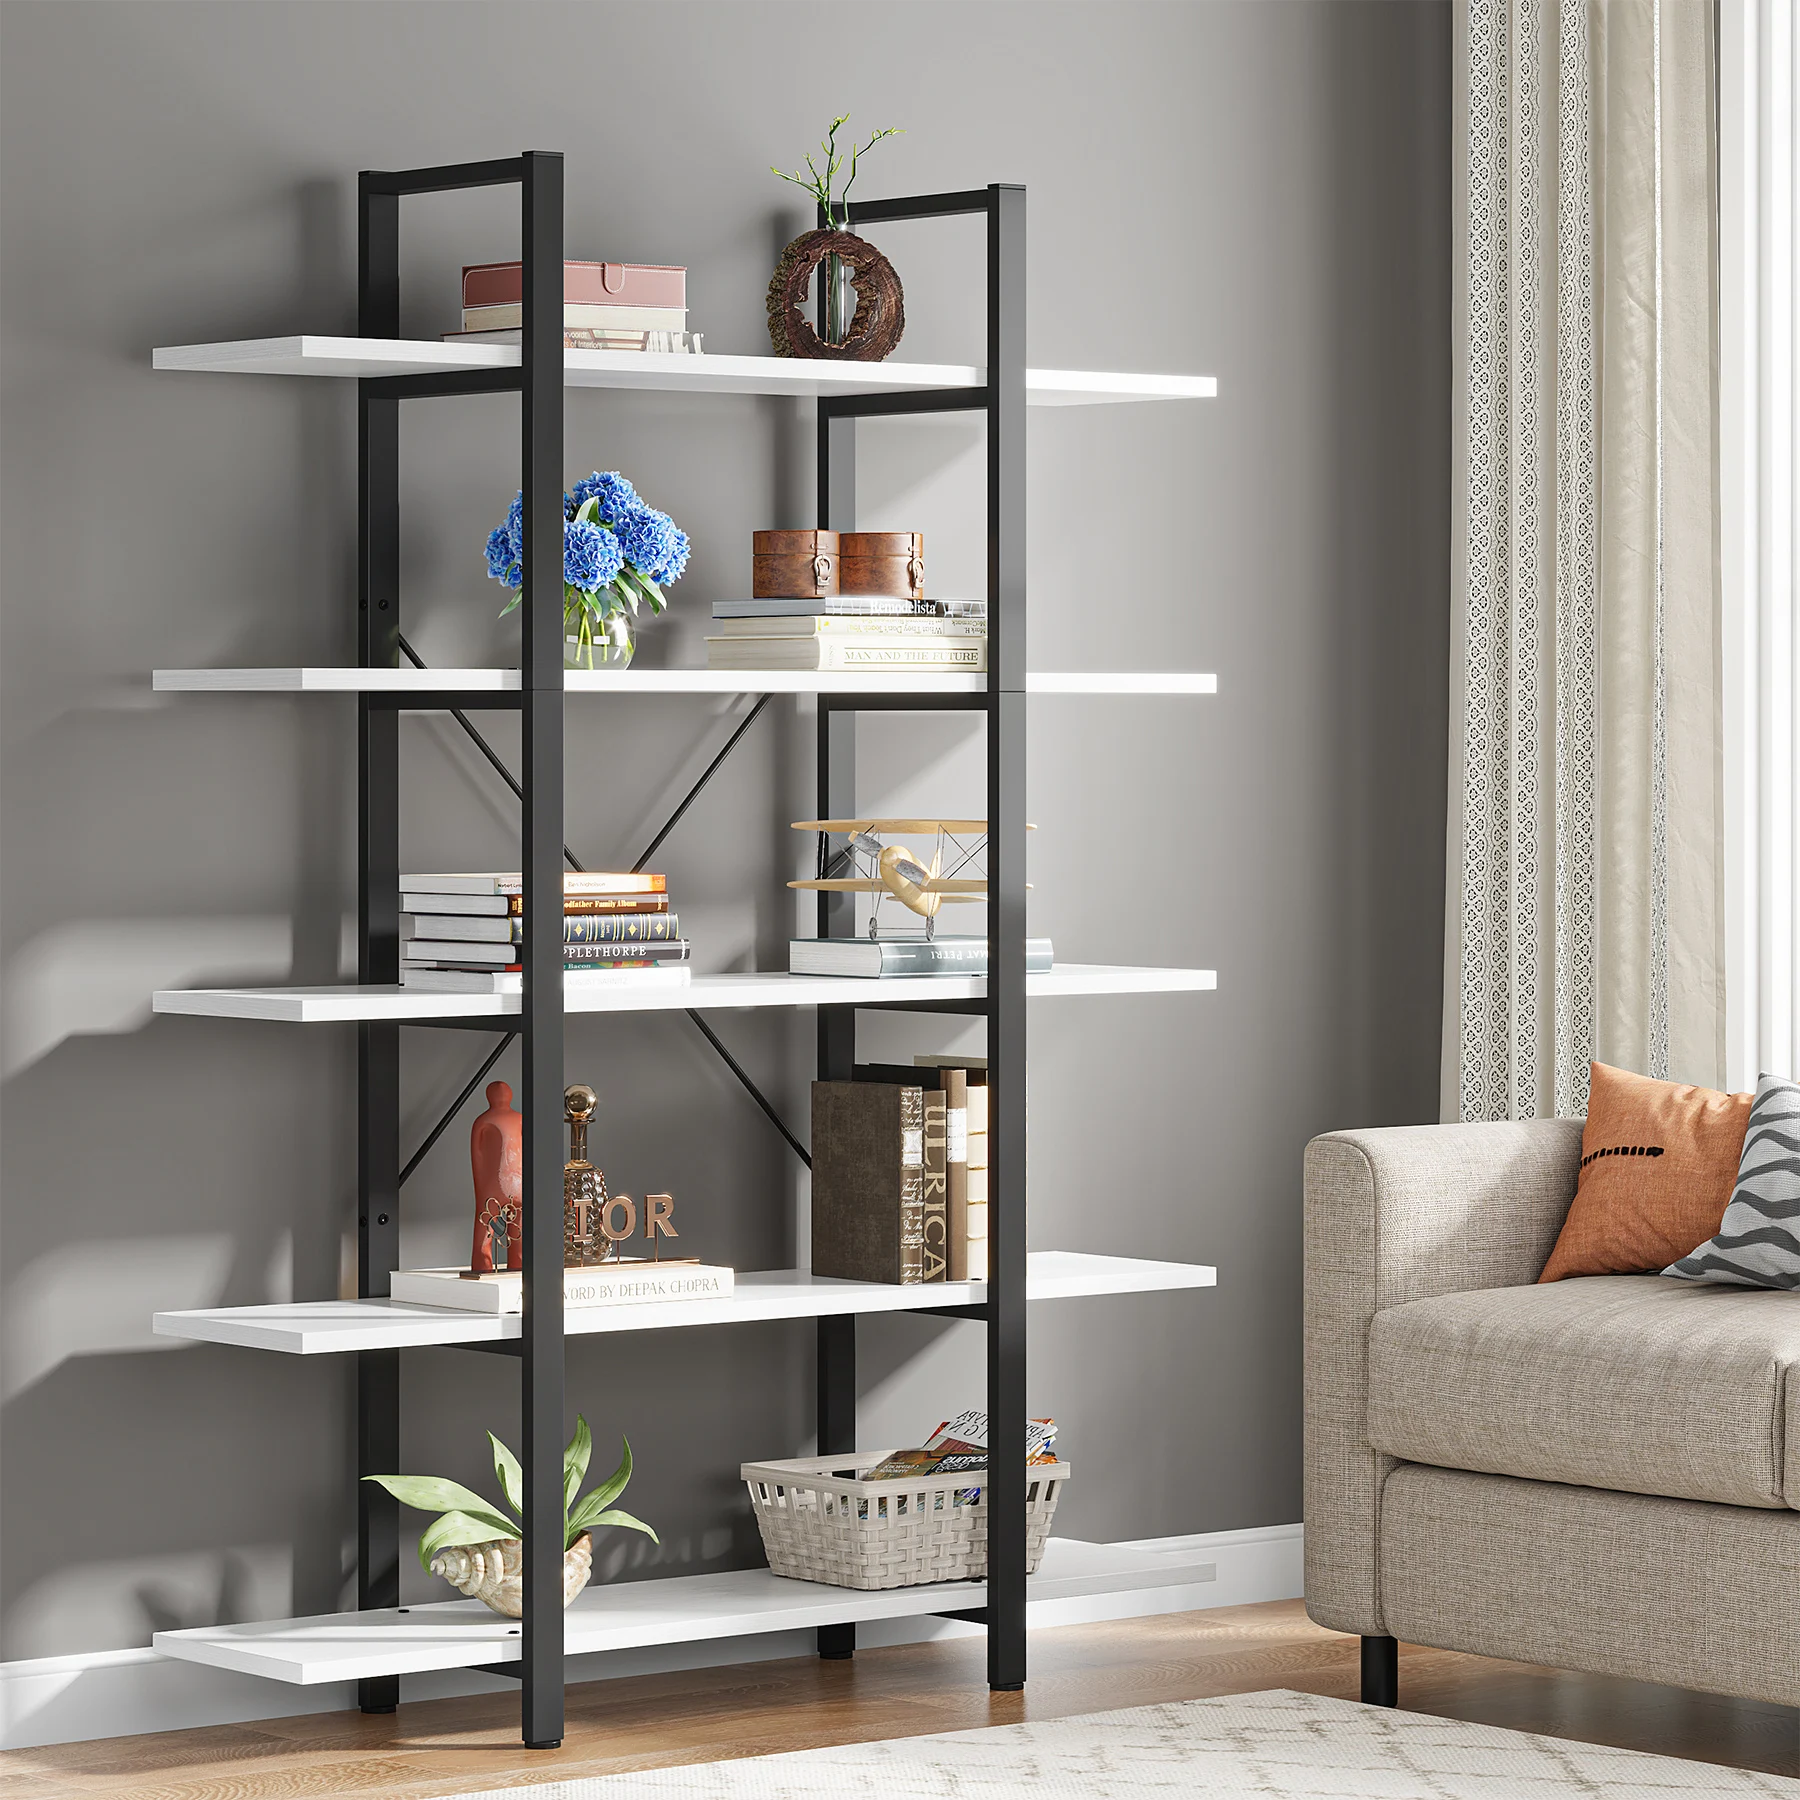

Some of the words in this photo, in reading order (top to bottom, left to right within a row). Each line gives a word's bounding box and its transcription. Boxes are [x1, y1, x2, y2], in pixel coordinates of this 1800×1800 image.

[870, 600, 936, 614] Remodelista
[845, 651, 872, 660] MAN
[875, 651, 901, 660] AND
[904, 652, 928, 660] THE
[933, 652, 979, 661] FUTURE
[595, 900, 617, 908] Family
[931, 950, 963, 960] PETRI
[600, 1285, 616, 1299] BY
[619, 1281, 666, 1297] DEEPAK
[670, 1278, 719, 1293] CHOPRA
